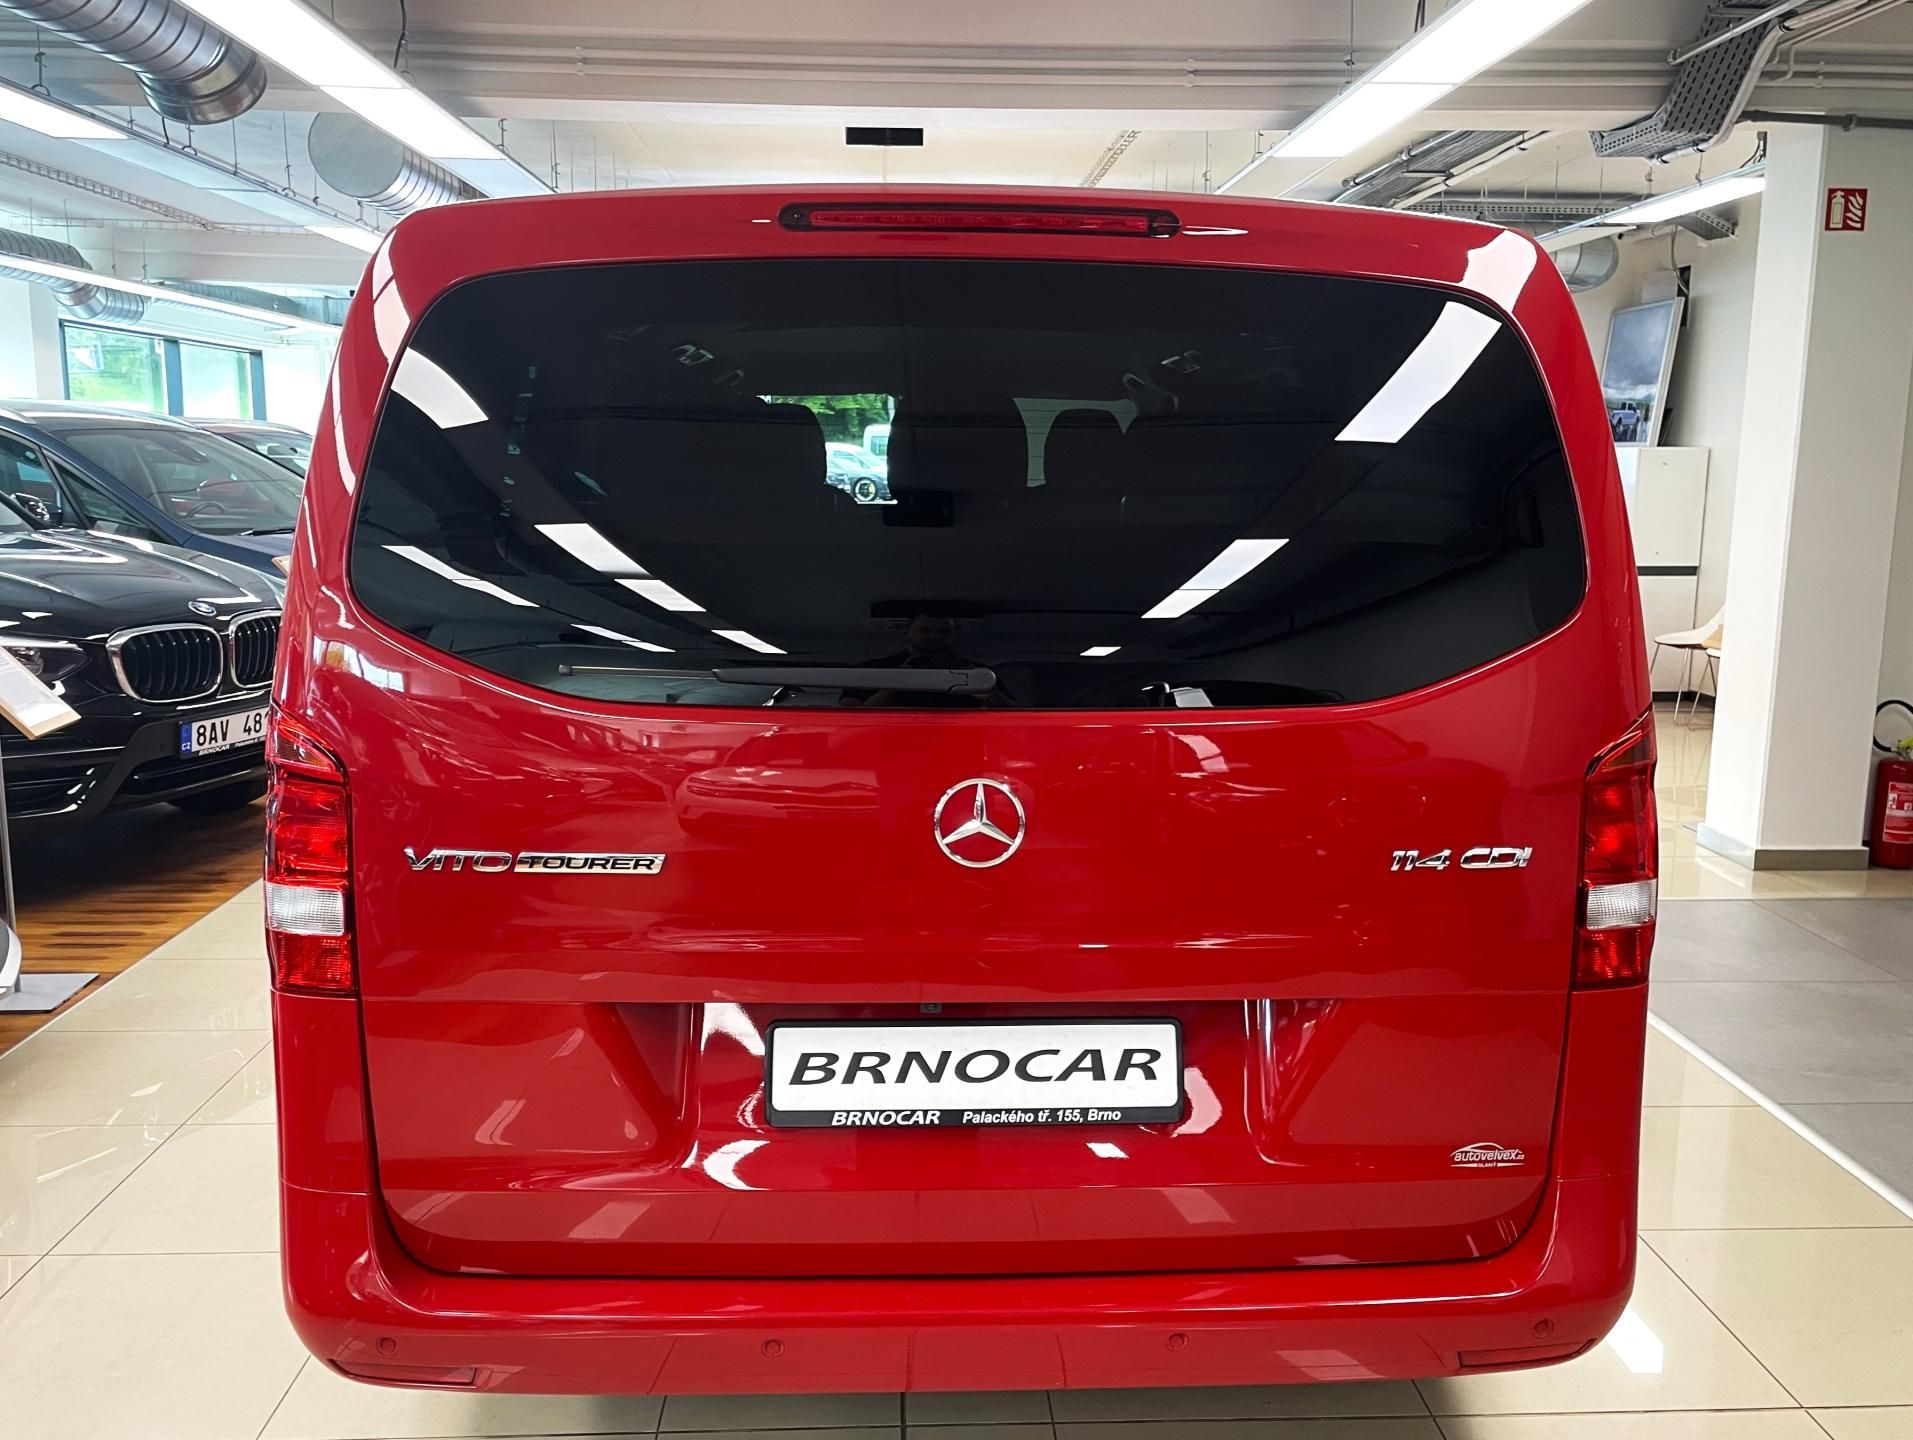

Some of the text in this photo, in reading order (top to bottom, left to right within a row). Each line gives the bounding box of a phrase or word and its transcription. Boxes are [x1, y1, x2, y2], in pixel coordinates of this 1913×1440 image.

[197, 710, 270, 747] 8AV 48
[181, 743, 191, 751] CZ
[403, 848, 656, 873] VITO TOURER
[1390, 847, 1533, 871] 114 CDI
[788, 1048, 1162, 1086] BRNOCAR
[831, 1109, 1122, 1126] BRNOCAR Palackého tř. 155, Brno
